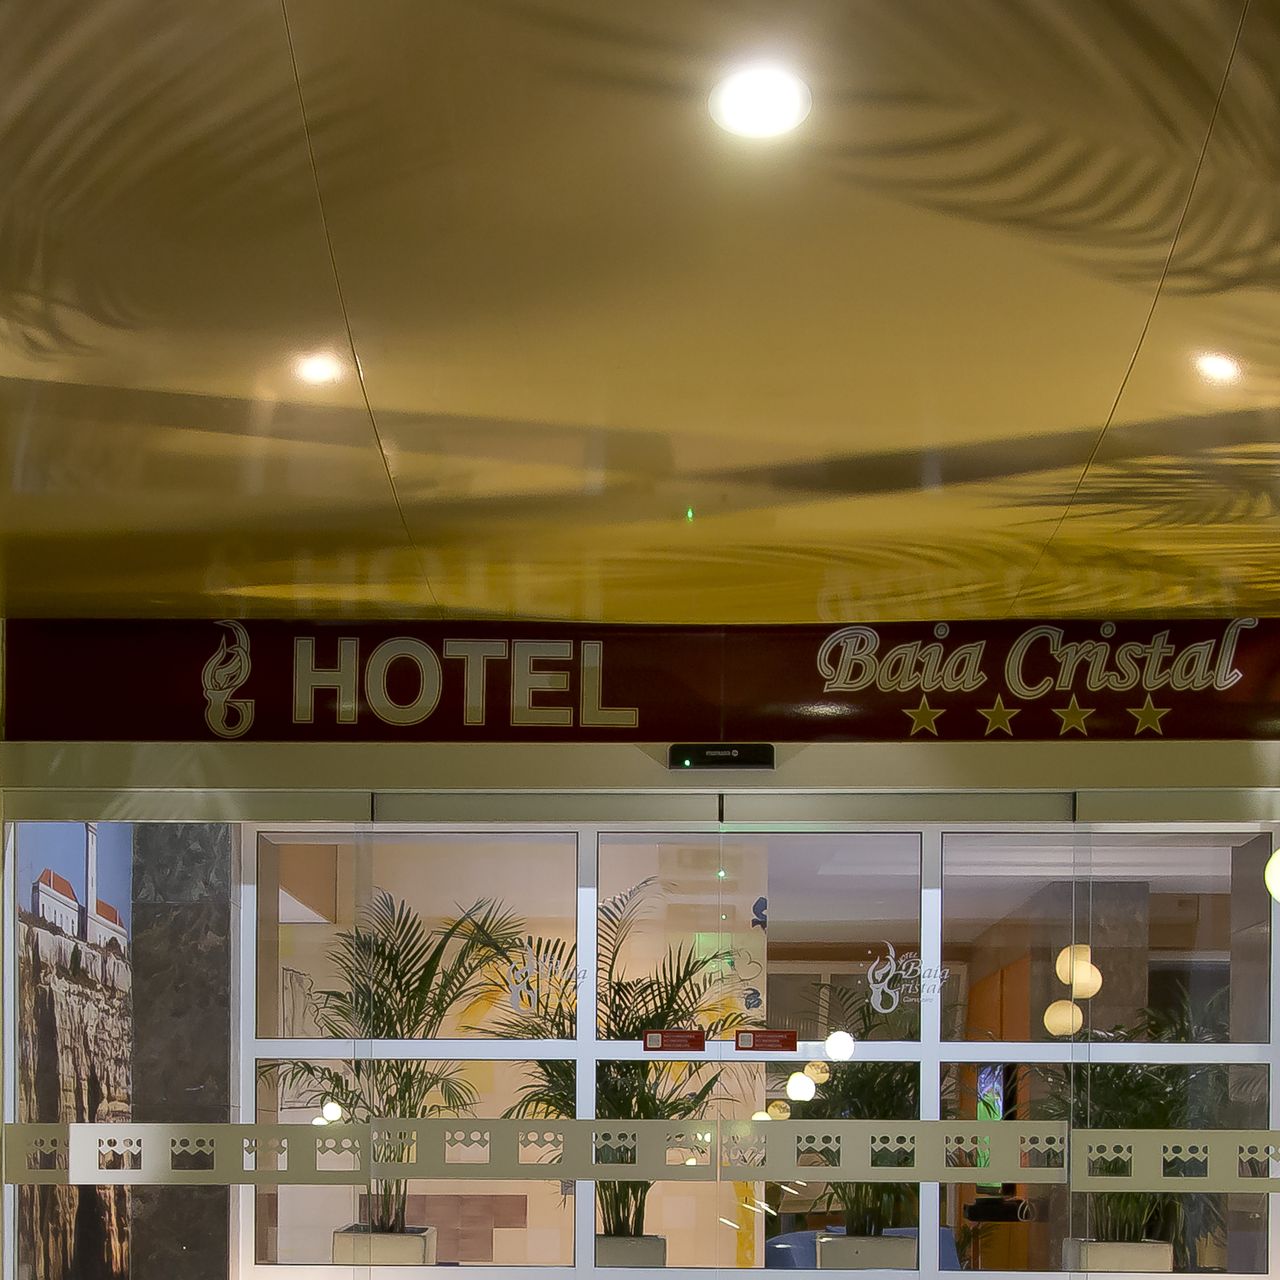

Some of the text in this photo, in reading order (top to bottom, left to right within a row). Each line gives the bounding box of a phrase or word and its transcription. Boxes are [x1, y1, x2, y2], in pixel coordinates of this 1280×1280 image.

[292, 636, 639, 728] HOTEL
[816, 617, 1260, 700] Baia Cristal
[898, 958, 951, 979] Baia
